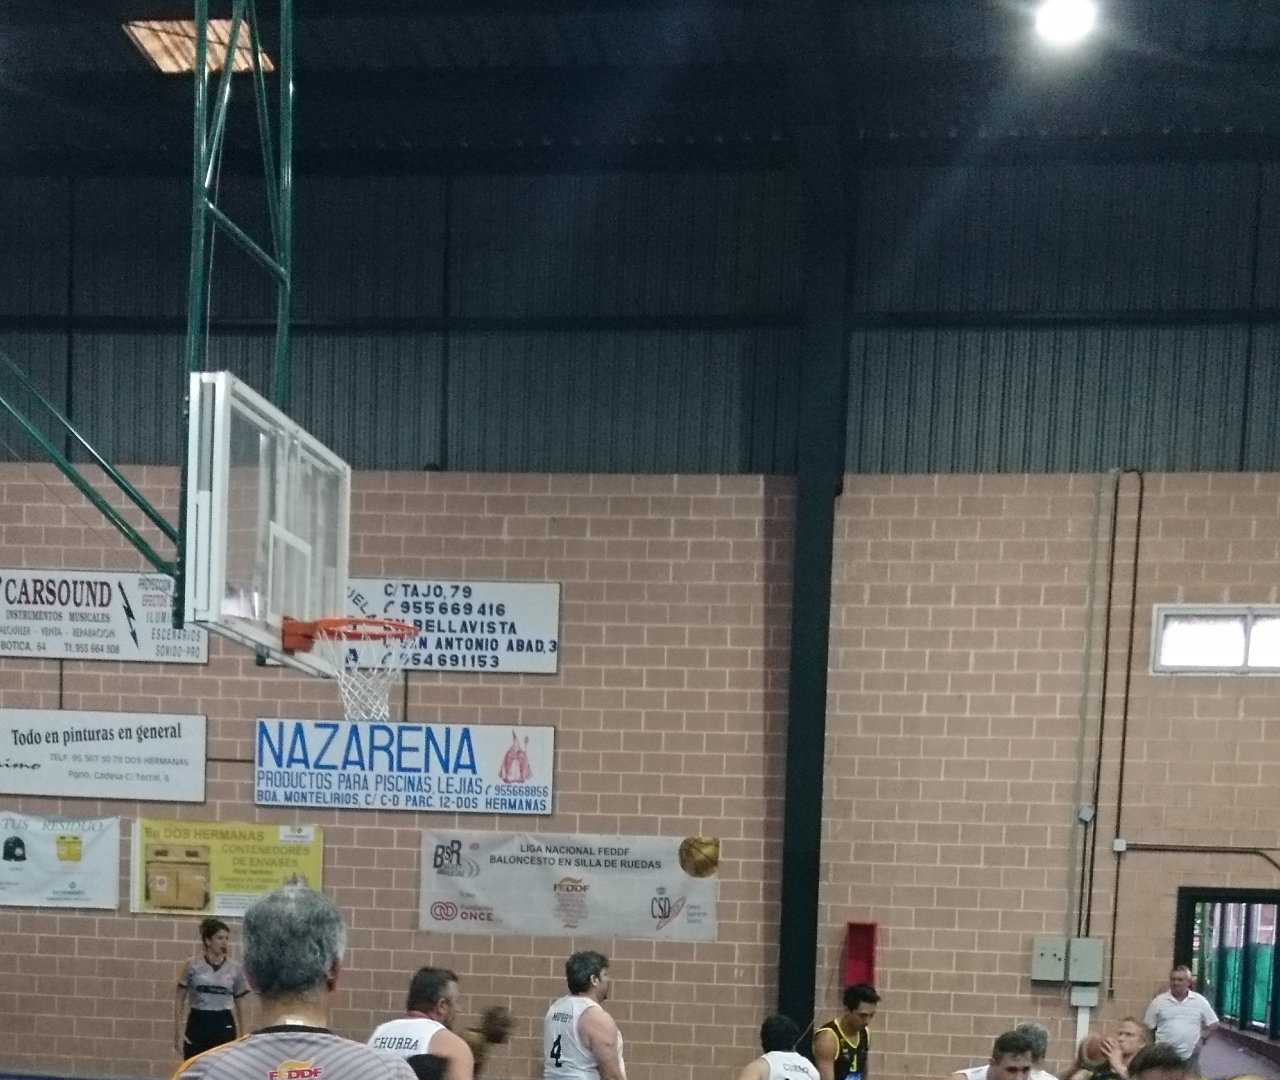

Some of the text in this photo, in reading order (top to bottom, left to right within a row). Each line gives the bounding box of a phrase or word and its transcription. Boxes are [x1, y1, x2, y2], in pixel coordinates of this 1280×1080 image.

[5, 578, 112, 608] CARSOUND
[69, 612, 110, 623] MUSICALES
[435, 637, 498, 651] ANTONIO
[11, 723, 182, 746] Todo en pinturas en general
[257, 721, 477, 774] NAZARENA
[257, 770, 332, 790] PRODUCTOS
[338, 773, 368, 791] PARA
[438, 776, 483, 795] LEJIAS
[485, 797, 546, 811] HERMANAS
[3, 817, 29, 831] TUS
[145, 828, 264, 841] En DOS HERMANAS
[221, 843, 310, 856] CONTENEDORES
[520, 844, 630, 856] LIGA NACIONAL FEDDF
[232, 856, 298, 868] DE ENVASES
[489, 855, 662, 869] BALONCESTO EN SILLA DE RUEDAS
[553, 884, 590, 893] FEDDF
[651, 897, 671, 920] CSD
[460, 911, 494, 921] ONCE
[549, 1034, 562, 1068] 4
